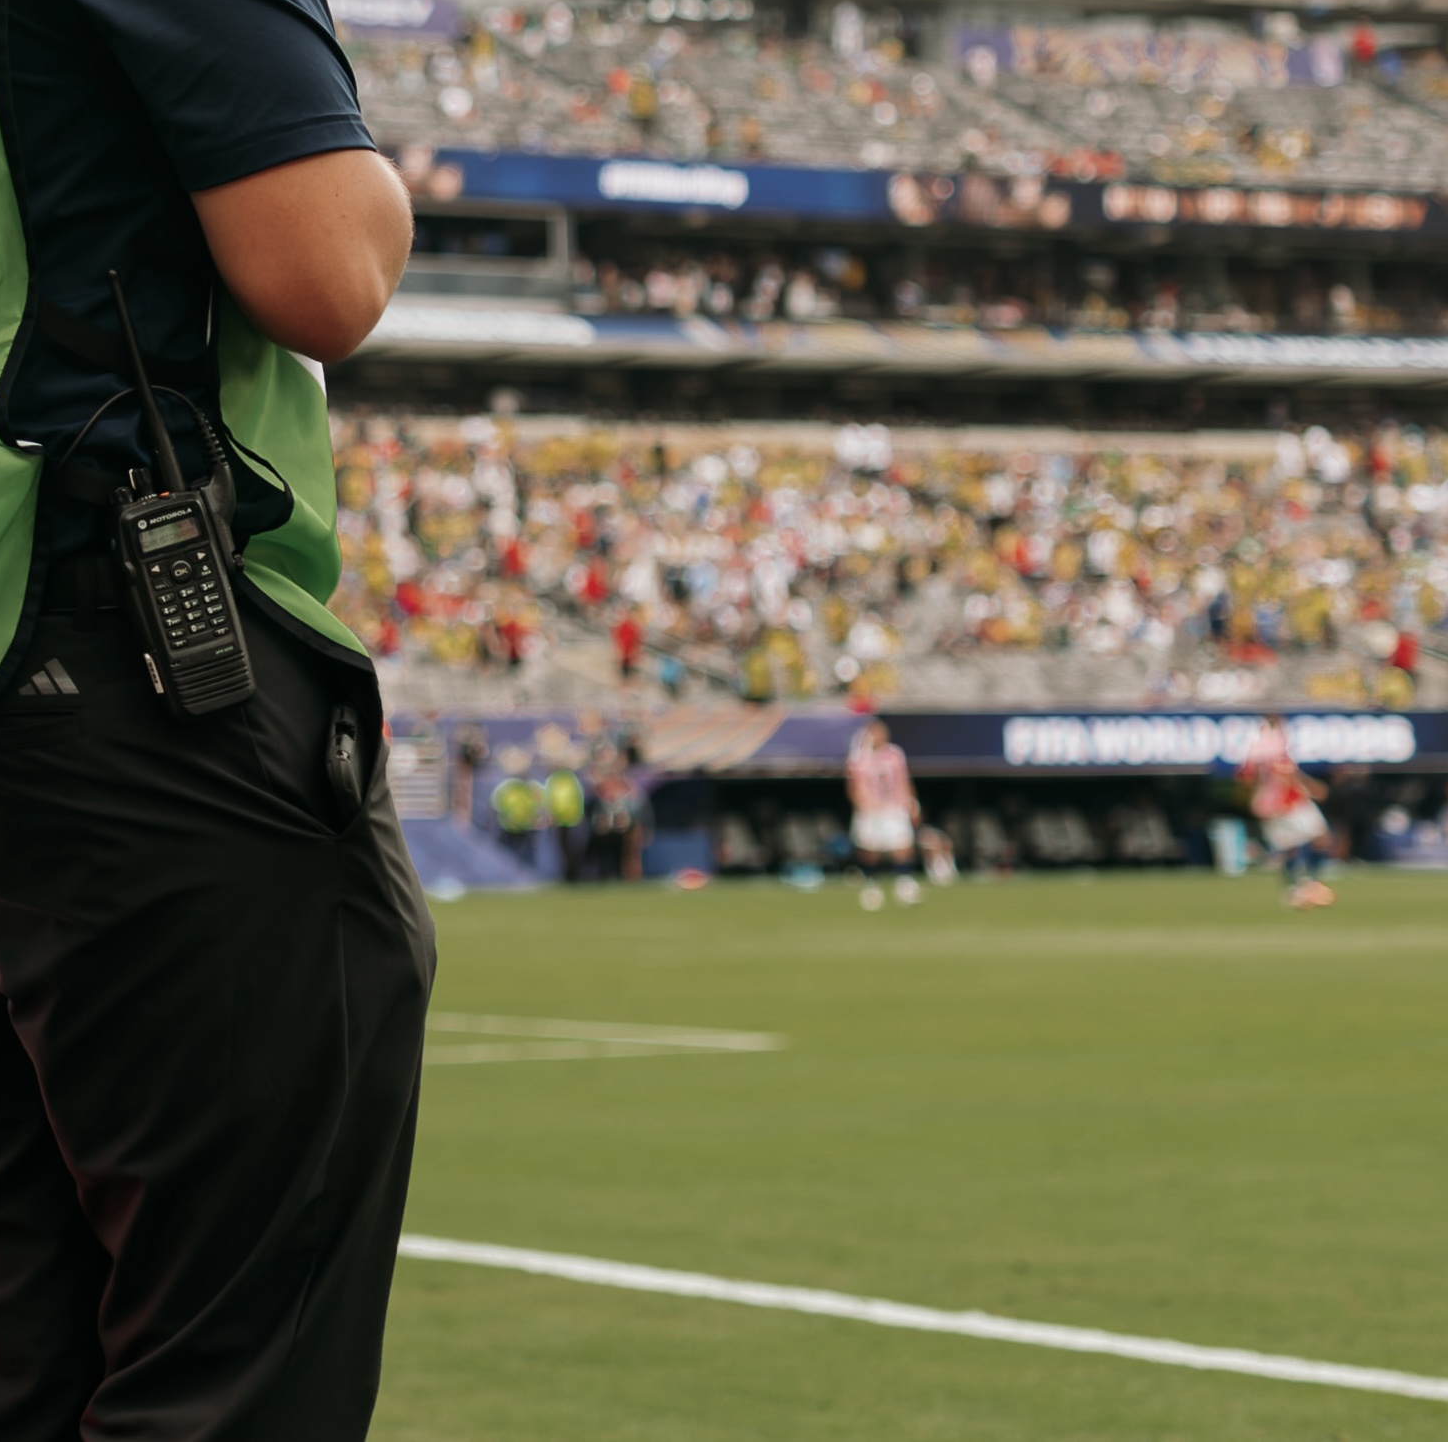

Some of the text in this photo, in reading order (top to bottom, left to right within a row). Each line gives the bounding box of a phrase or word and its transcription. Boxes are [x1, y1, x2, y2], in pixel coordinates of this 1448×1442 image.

[150, 508, 192, 525] MOTOROLA
[174, 567, 189, 577] OK
[1003, 716, 1090, 765] FIFA
[1090, 715, 1220, 765] WORLD
[1288, 715, 1416, 763] 2026
